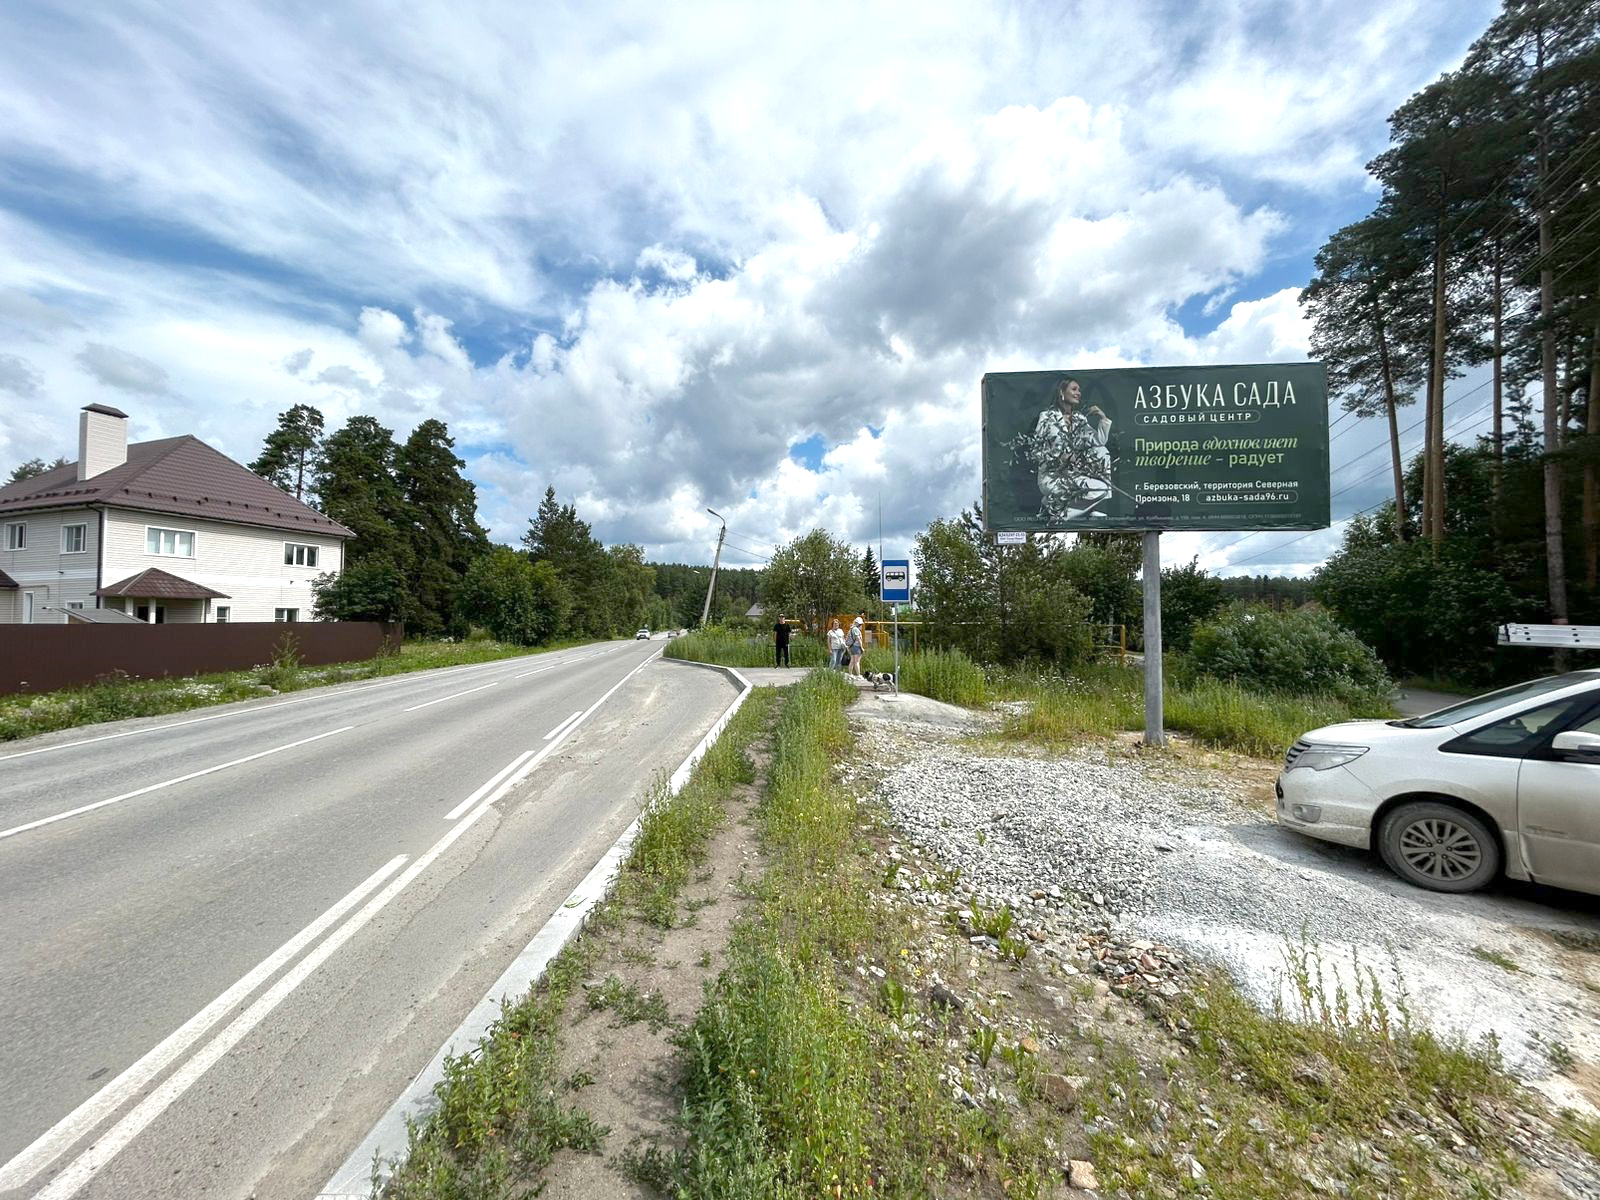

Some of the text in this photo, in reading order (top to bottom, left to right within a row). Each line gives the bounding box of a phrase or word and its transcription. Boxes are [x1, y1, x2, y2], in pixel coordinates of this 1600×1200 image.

[1134, 380, 1297, 410] АЗБУКА САДА
[1143, 412, 1252, 424] САДОВЫЙ ЦЕНТР
[1134, 436, 1298, 454] Природа вдохновляет
[1135, 453, 1212, 468] творение
[1229, 452, 1285, 468] радует
[1135, 480, 1299, 492] г. Березовский, территория Северная
[1135, 494, 1190, 504] Промзона, 18
[1205, 492, 1290, 502] azbuka-sada96.ru
